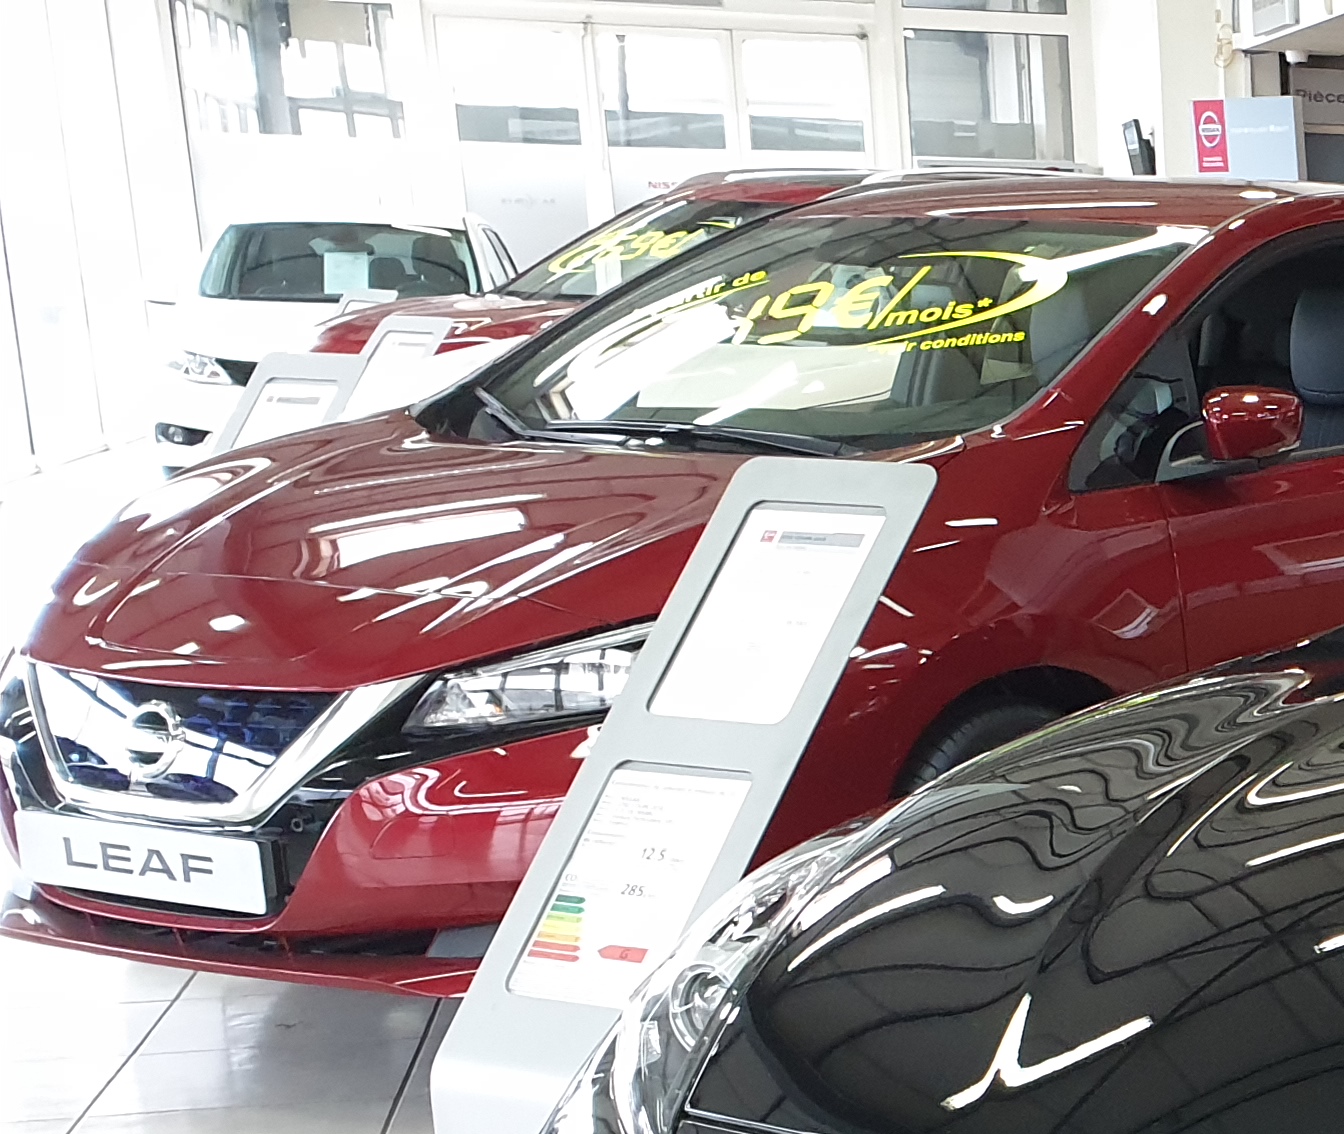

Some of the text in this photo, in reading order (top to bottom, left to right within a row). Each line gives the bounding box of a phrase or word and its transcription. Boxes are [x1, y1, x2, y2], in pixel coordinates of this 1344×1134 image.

[732, 270, 768, 287] de
[919, 331, 1026, 351] conditions
[62, 836, 214, 884] LEAF
[620, 883, 645, 897] 285
